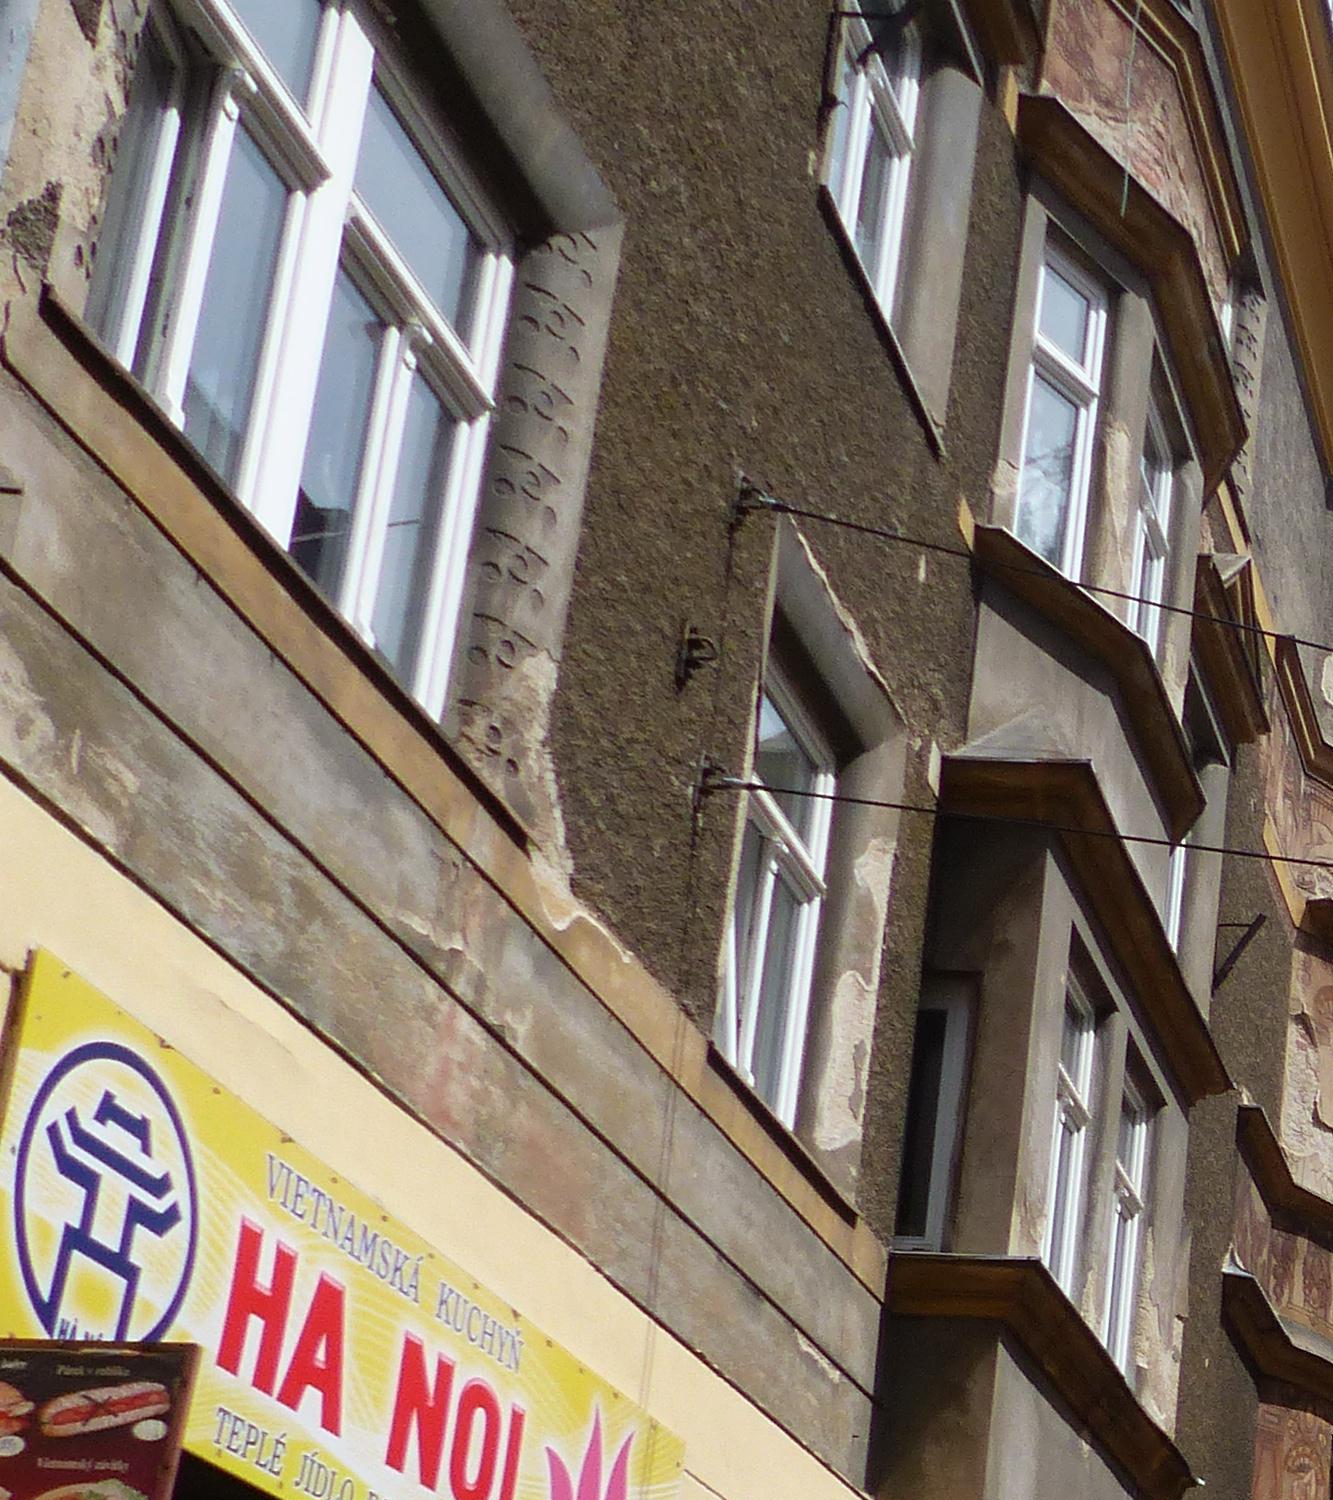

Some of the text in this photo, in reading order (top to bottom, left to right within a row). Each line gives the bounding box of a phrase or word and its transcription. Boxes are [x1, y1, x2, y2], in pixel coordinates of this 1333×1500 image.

[215, 1215, 346, 1439] HA
[266, 1153, 525, 1373] VIETNAMSKÁ KUCHYŇ
[213, 1407, 287, 1477] TEPLÉ
